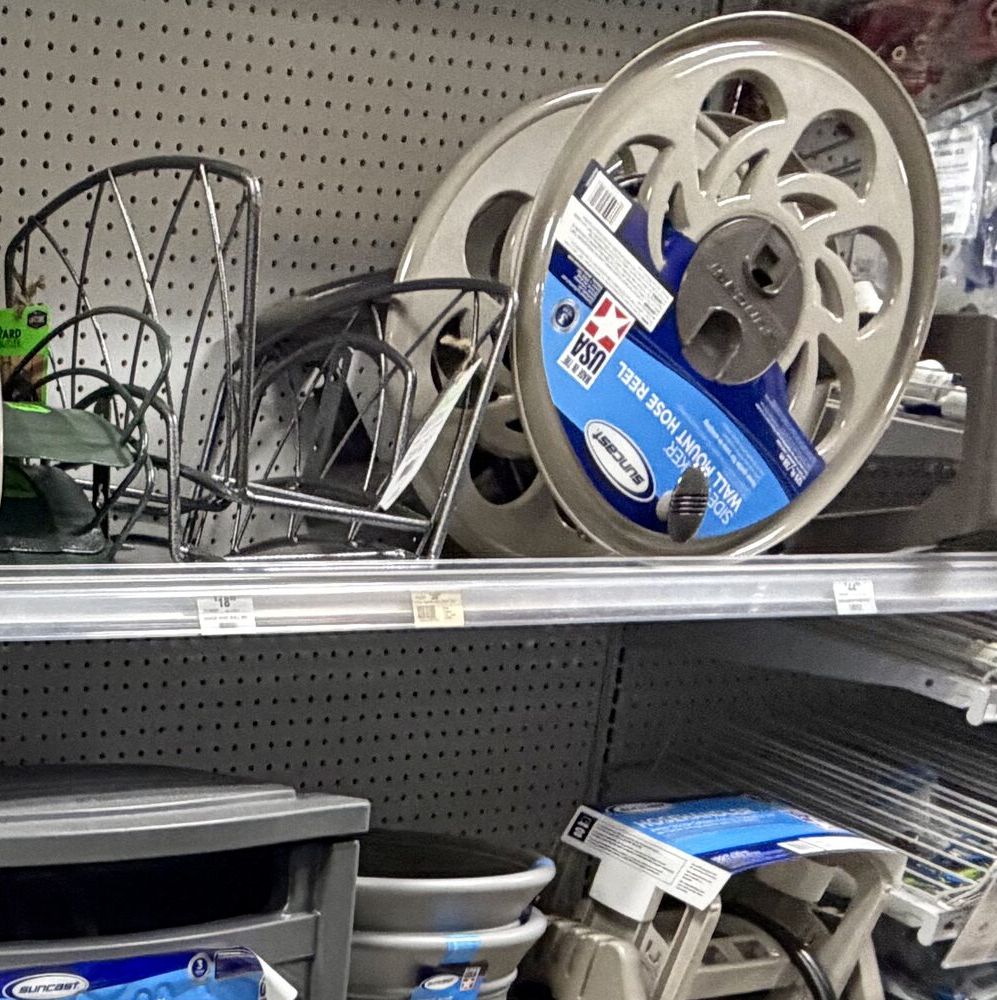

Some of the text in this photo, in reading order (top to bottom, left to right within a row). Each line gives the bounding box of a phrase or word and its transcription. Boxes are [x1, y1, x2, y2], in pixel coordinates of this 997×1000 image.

[568, 332, 607, 373] USA
[616, 362, 650, 403] REEL
[648, 394, 681, 439] HOSE
[591, 429, 644, 488] suncast
[668, 428, 714, 482] MOUNT
[714, 471, 743, 511] WALL
[18, 981, 80, 994] suncast
